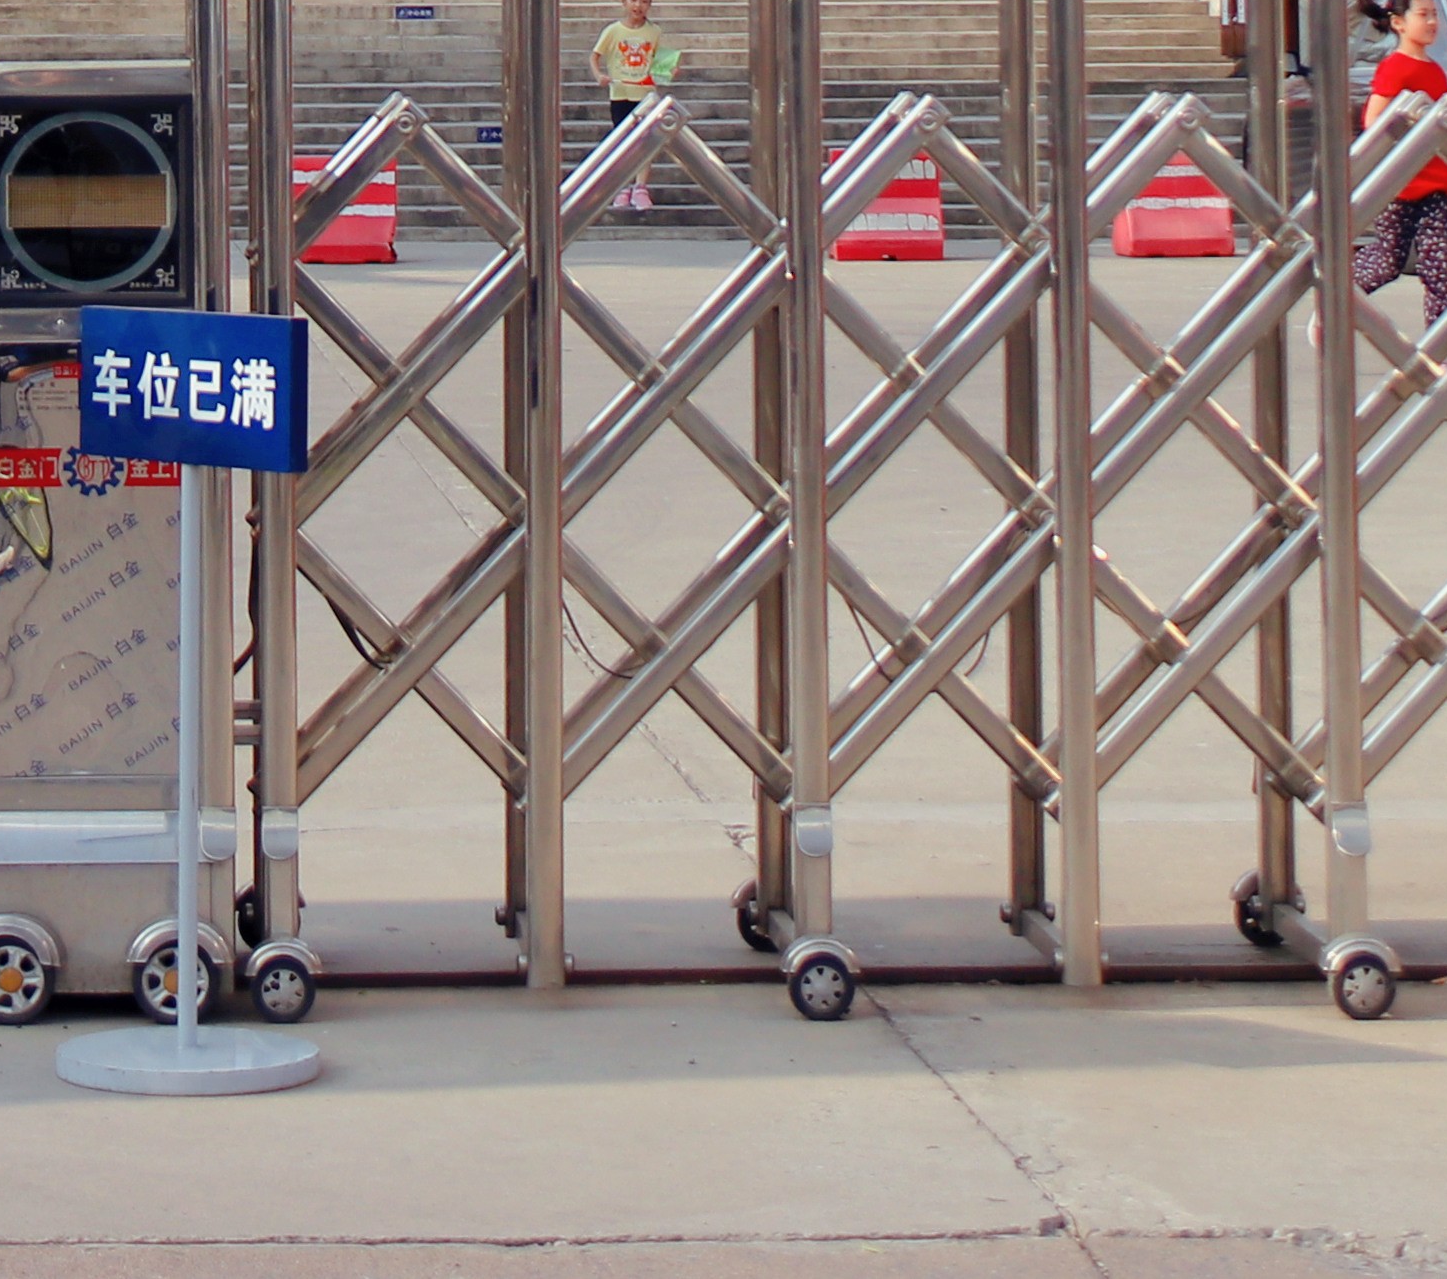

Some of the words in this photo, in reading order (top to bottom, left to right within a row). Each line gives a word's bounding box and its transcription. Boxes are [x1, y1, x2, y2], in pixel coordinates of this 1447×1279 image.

[92, 348, 277, 431] 车位已满
[58, 540, 104, 575] BAIJIN
[106, 512, 140, 540] 白金
[61, 587, 107, 623] BAIJIN
[109, 560, 142, 588] 白金
[8, 623, 40, 651] 白金
[68, 656, 113, 692] BAIJIN
[114, 628, 148, 656] 白金
[14, 693, 49, 722] 白金
[58, 718, 103, 755] BAIJIN
[105, 692, 139, 720] 白金
[124, 732, 170, 768] BAIJIN
